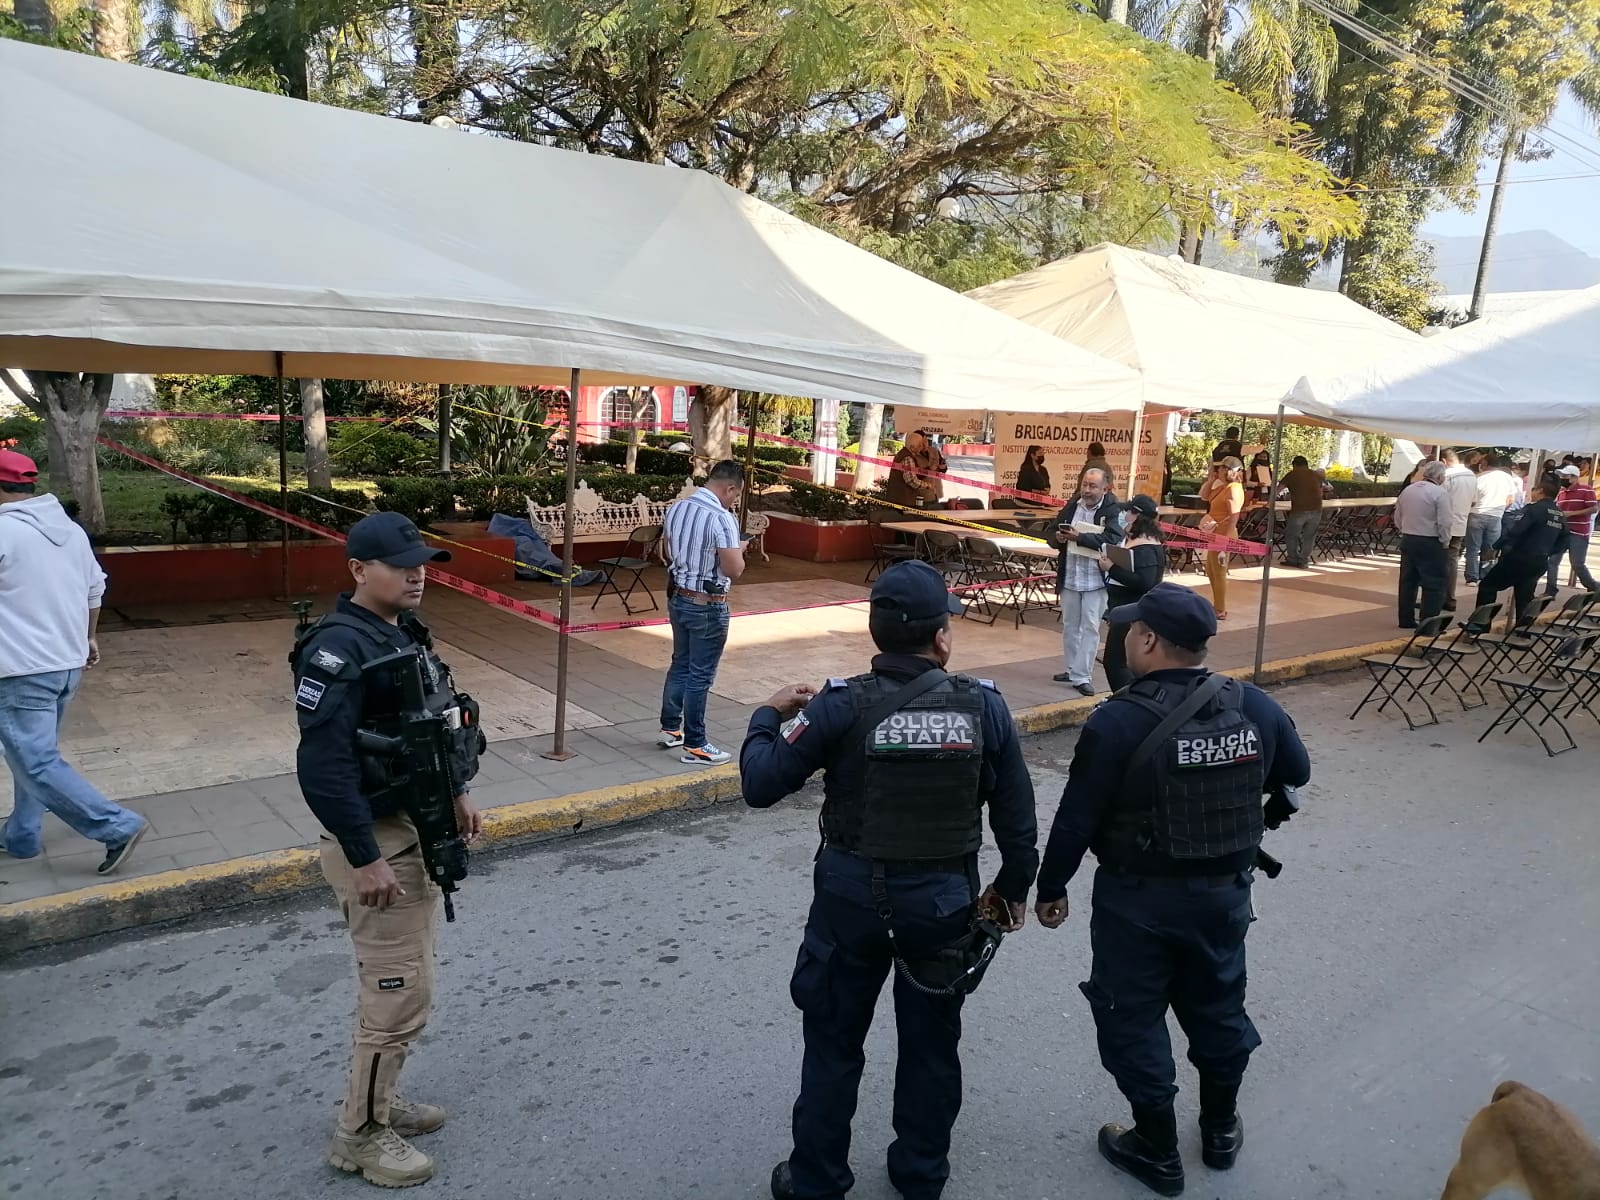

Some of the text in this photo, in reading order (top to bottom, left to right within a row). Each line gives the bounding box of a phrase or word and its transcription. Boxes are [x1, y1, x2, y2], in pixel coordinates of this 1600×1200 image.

[1015, 424, 1152, 444] BRIGADAS ITINERANES
[1002, 445, 1027, 454] INSTITU
[1040, 446, 1083, 456] ERACRUZANO
[874, 729, 973, 745] ESTATAL
[1177, 729, 1257, 753] POLICÍA
[1177, 742, 1258, 765] ESTATAL
